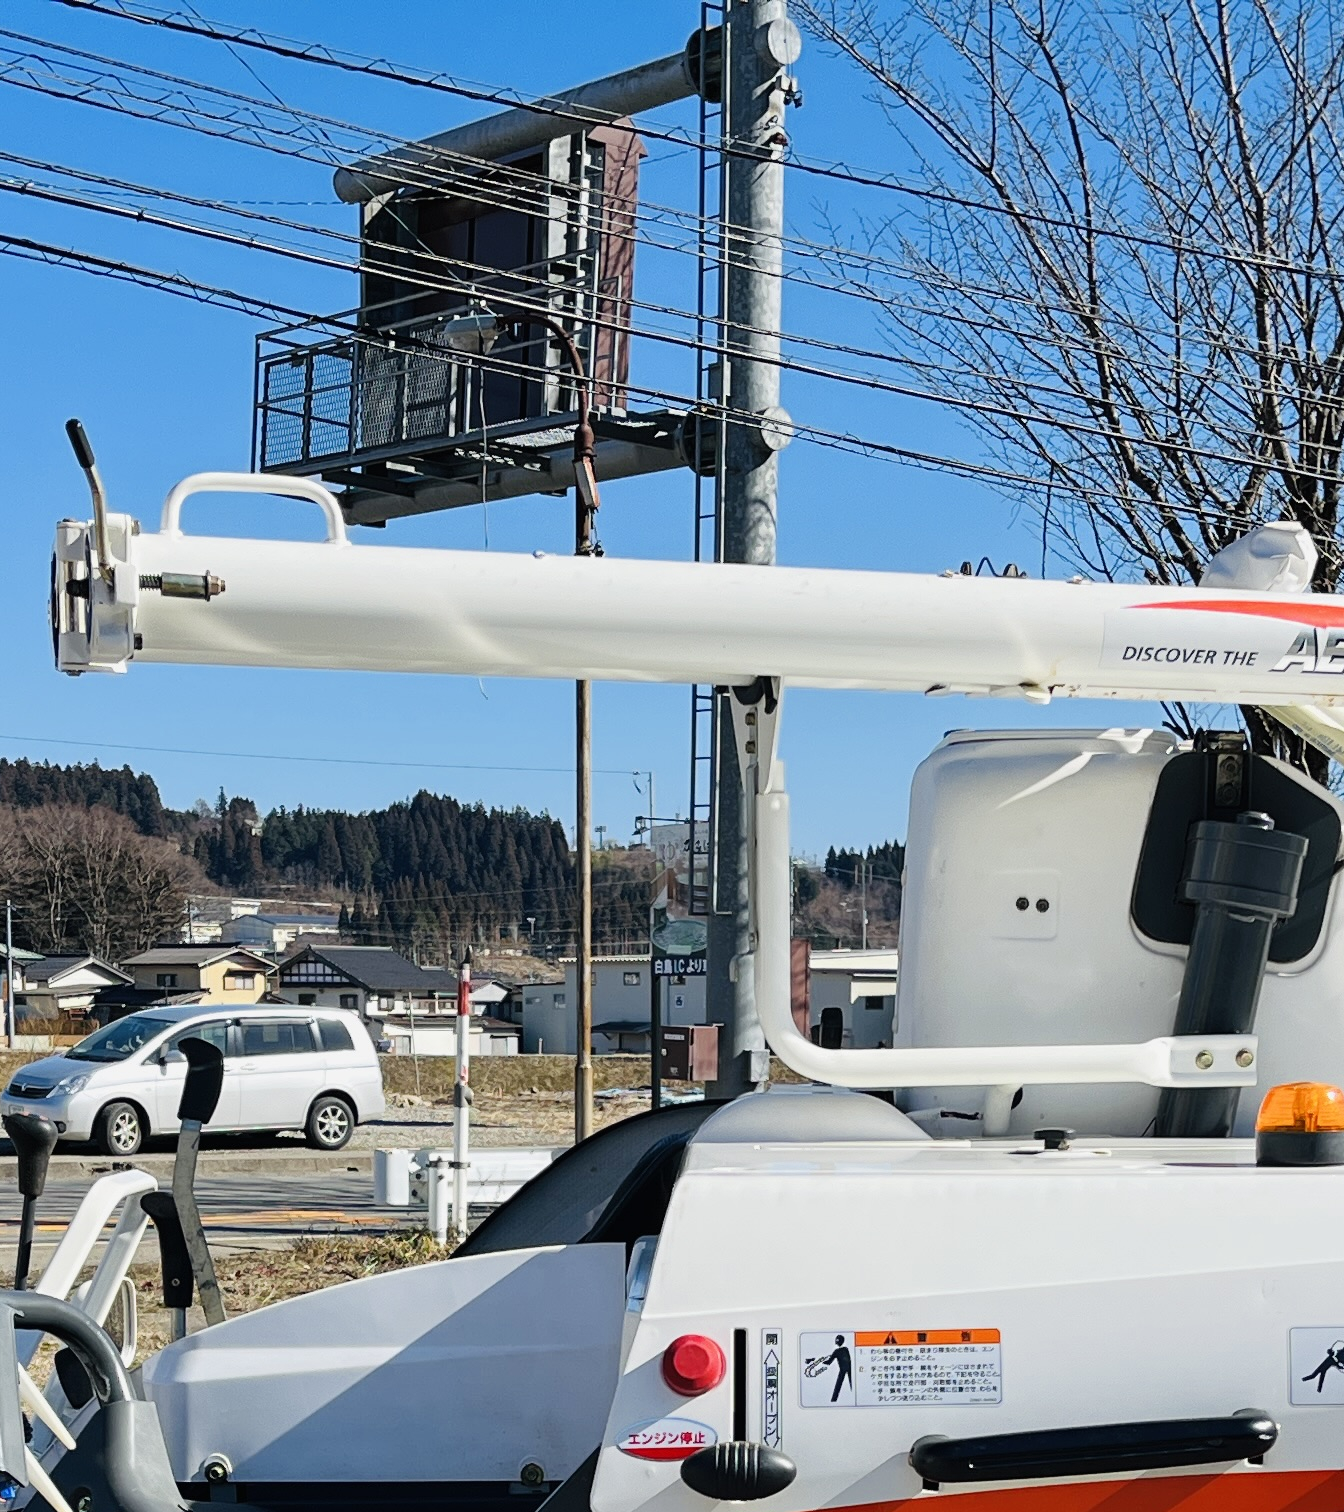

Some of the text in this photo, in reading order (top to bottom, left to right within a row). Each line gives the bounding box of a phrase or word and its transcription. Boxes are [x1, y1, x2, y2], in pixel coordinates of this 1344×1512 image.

[1122, 645, 1216, 667] DISCOVER
[1222, 647, 1258, 668] THE
[654, 959, 707, 974] 白鳥ICより
[628, 1431, 706, 1445] エンジン停止
